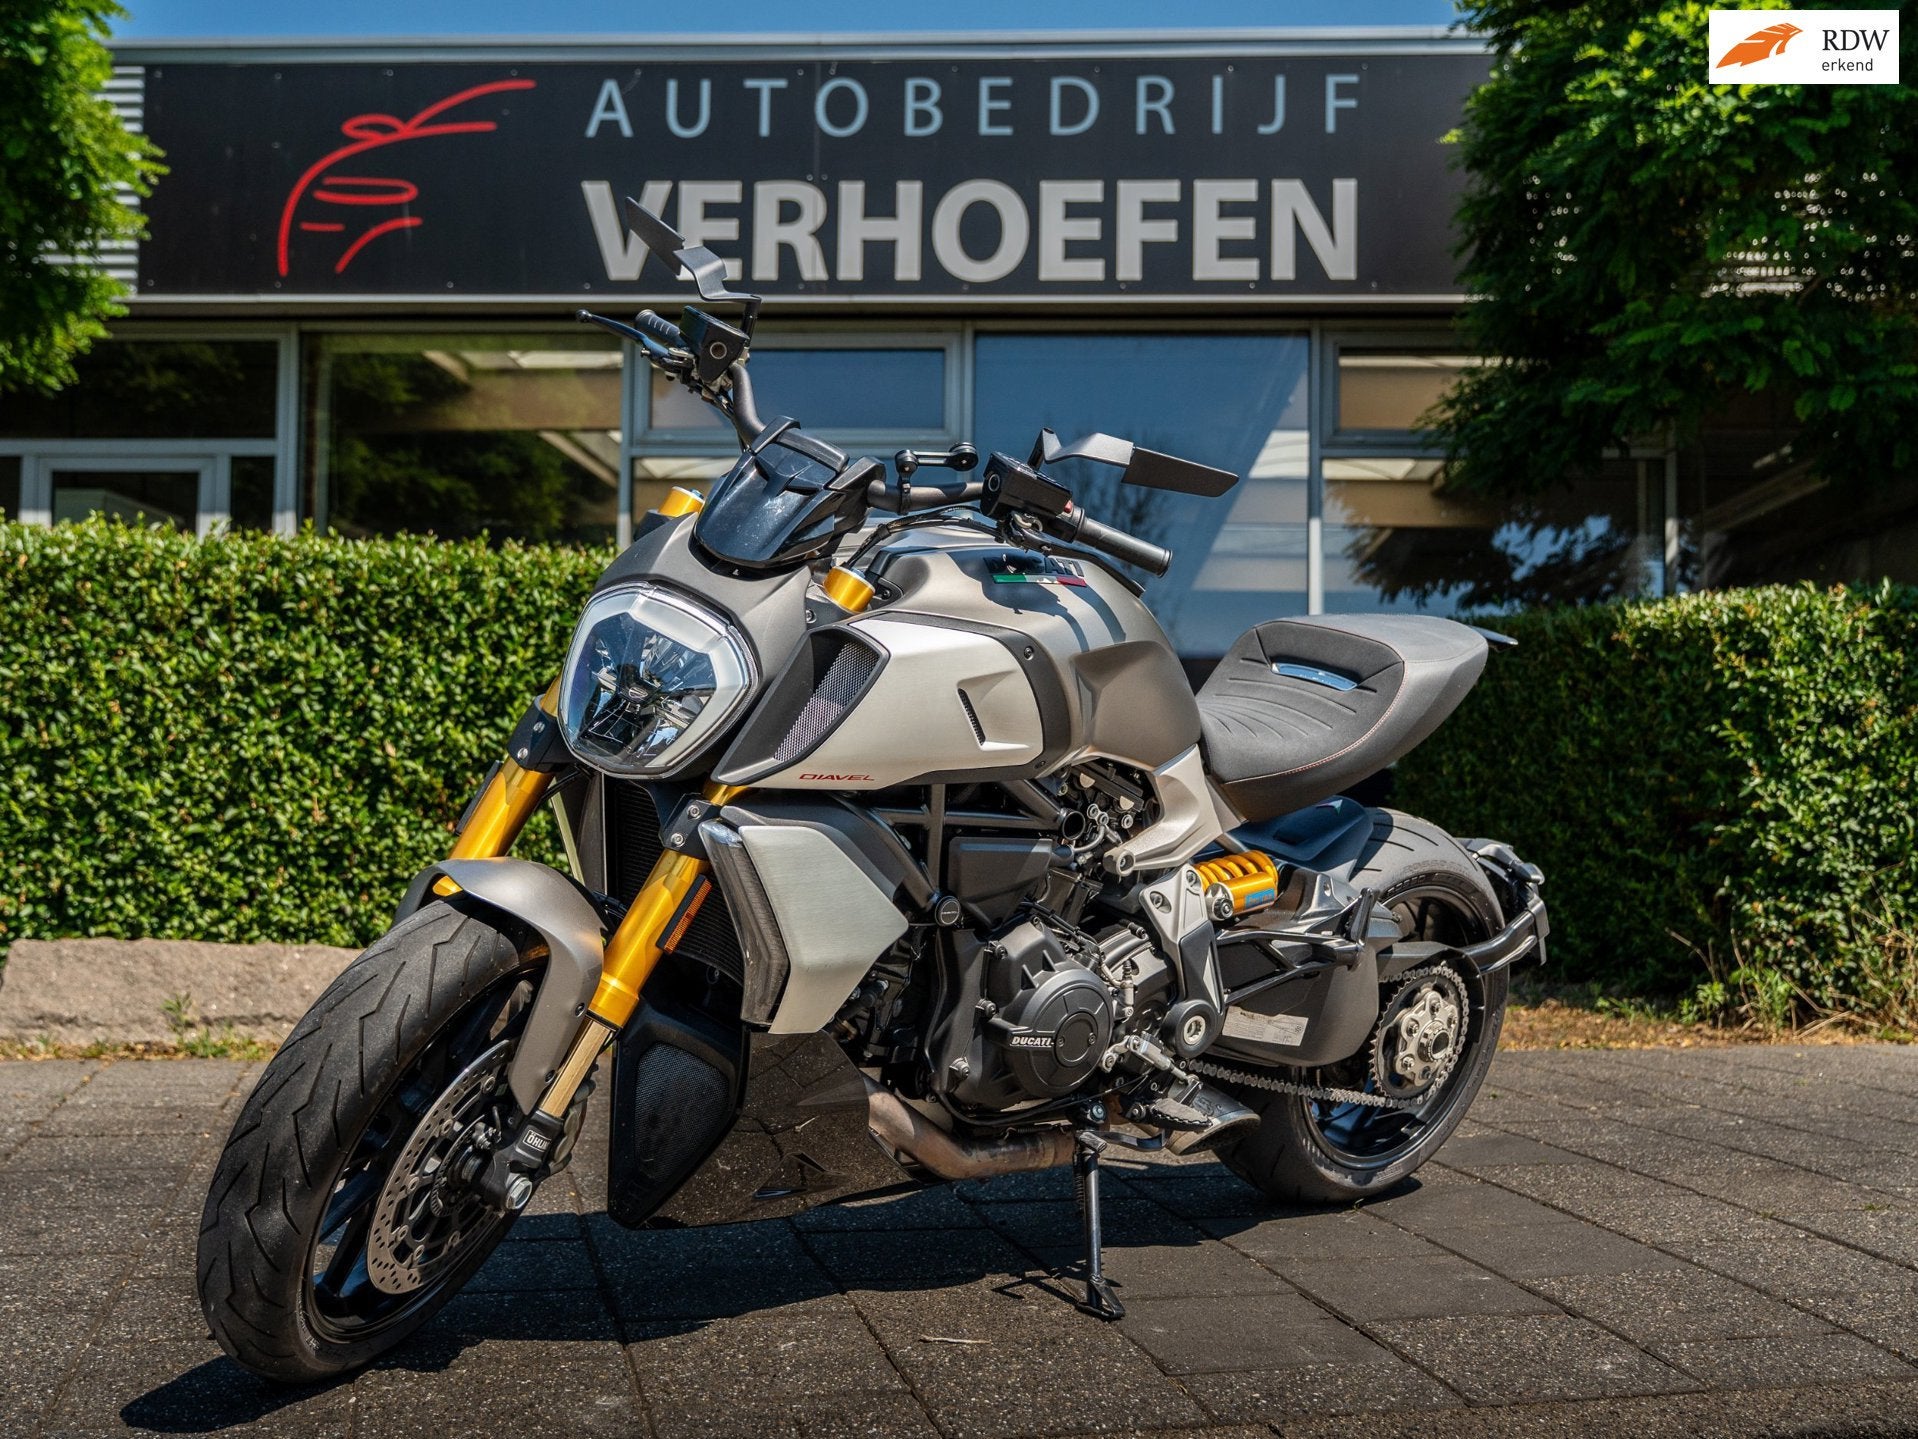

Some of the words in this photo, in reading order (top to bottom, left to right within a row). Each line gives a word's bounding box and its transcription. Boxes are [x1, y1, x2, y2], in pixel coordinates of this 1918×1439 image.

[584, 74, 1360, 137] AUTOBEDRIJF
[580, 179, 1359, 282] VERHOEFEN
[799, 773, 875, 781] DIAVEL
[1011, 1036, 1052, 1046] DUCATI
